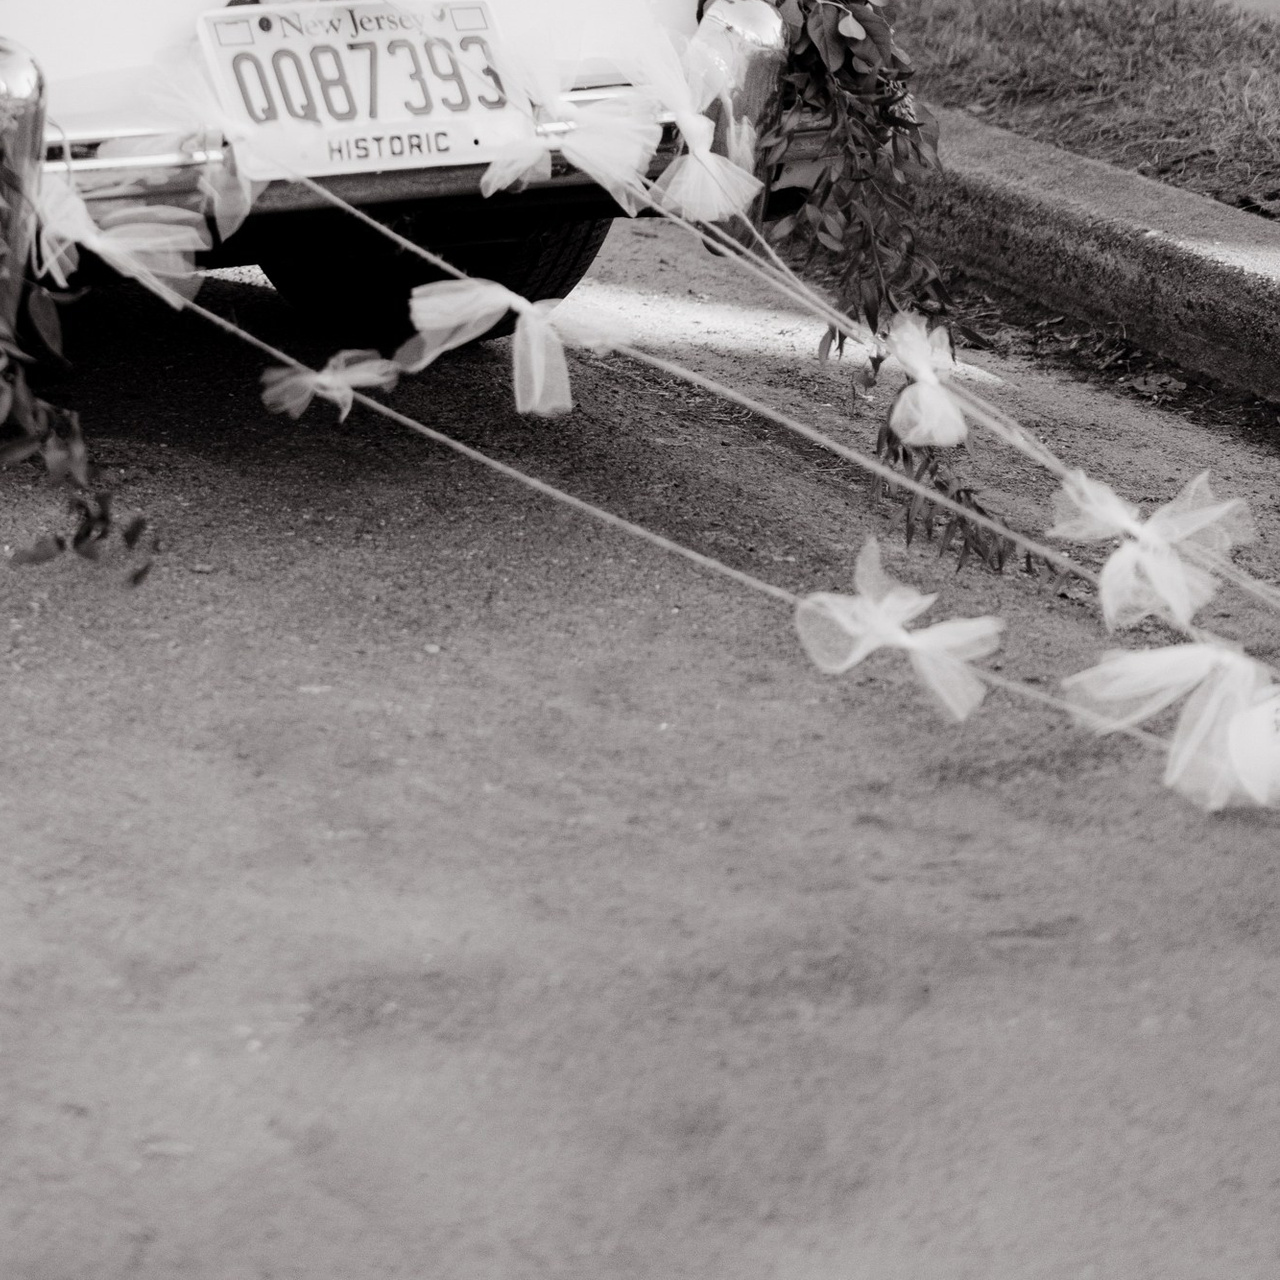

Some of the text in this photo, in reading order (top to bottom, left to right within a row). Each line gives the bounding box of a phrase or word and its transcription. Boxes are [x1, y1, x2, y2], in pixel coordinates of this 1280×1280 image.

[277, 8, 426, 38] New Jersey
[328, 131, 451, 162] HISTORIC
